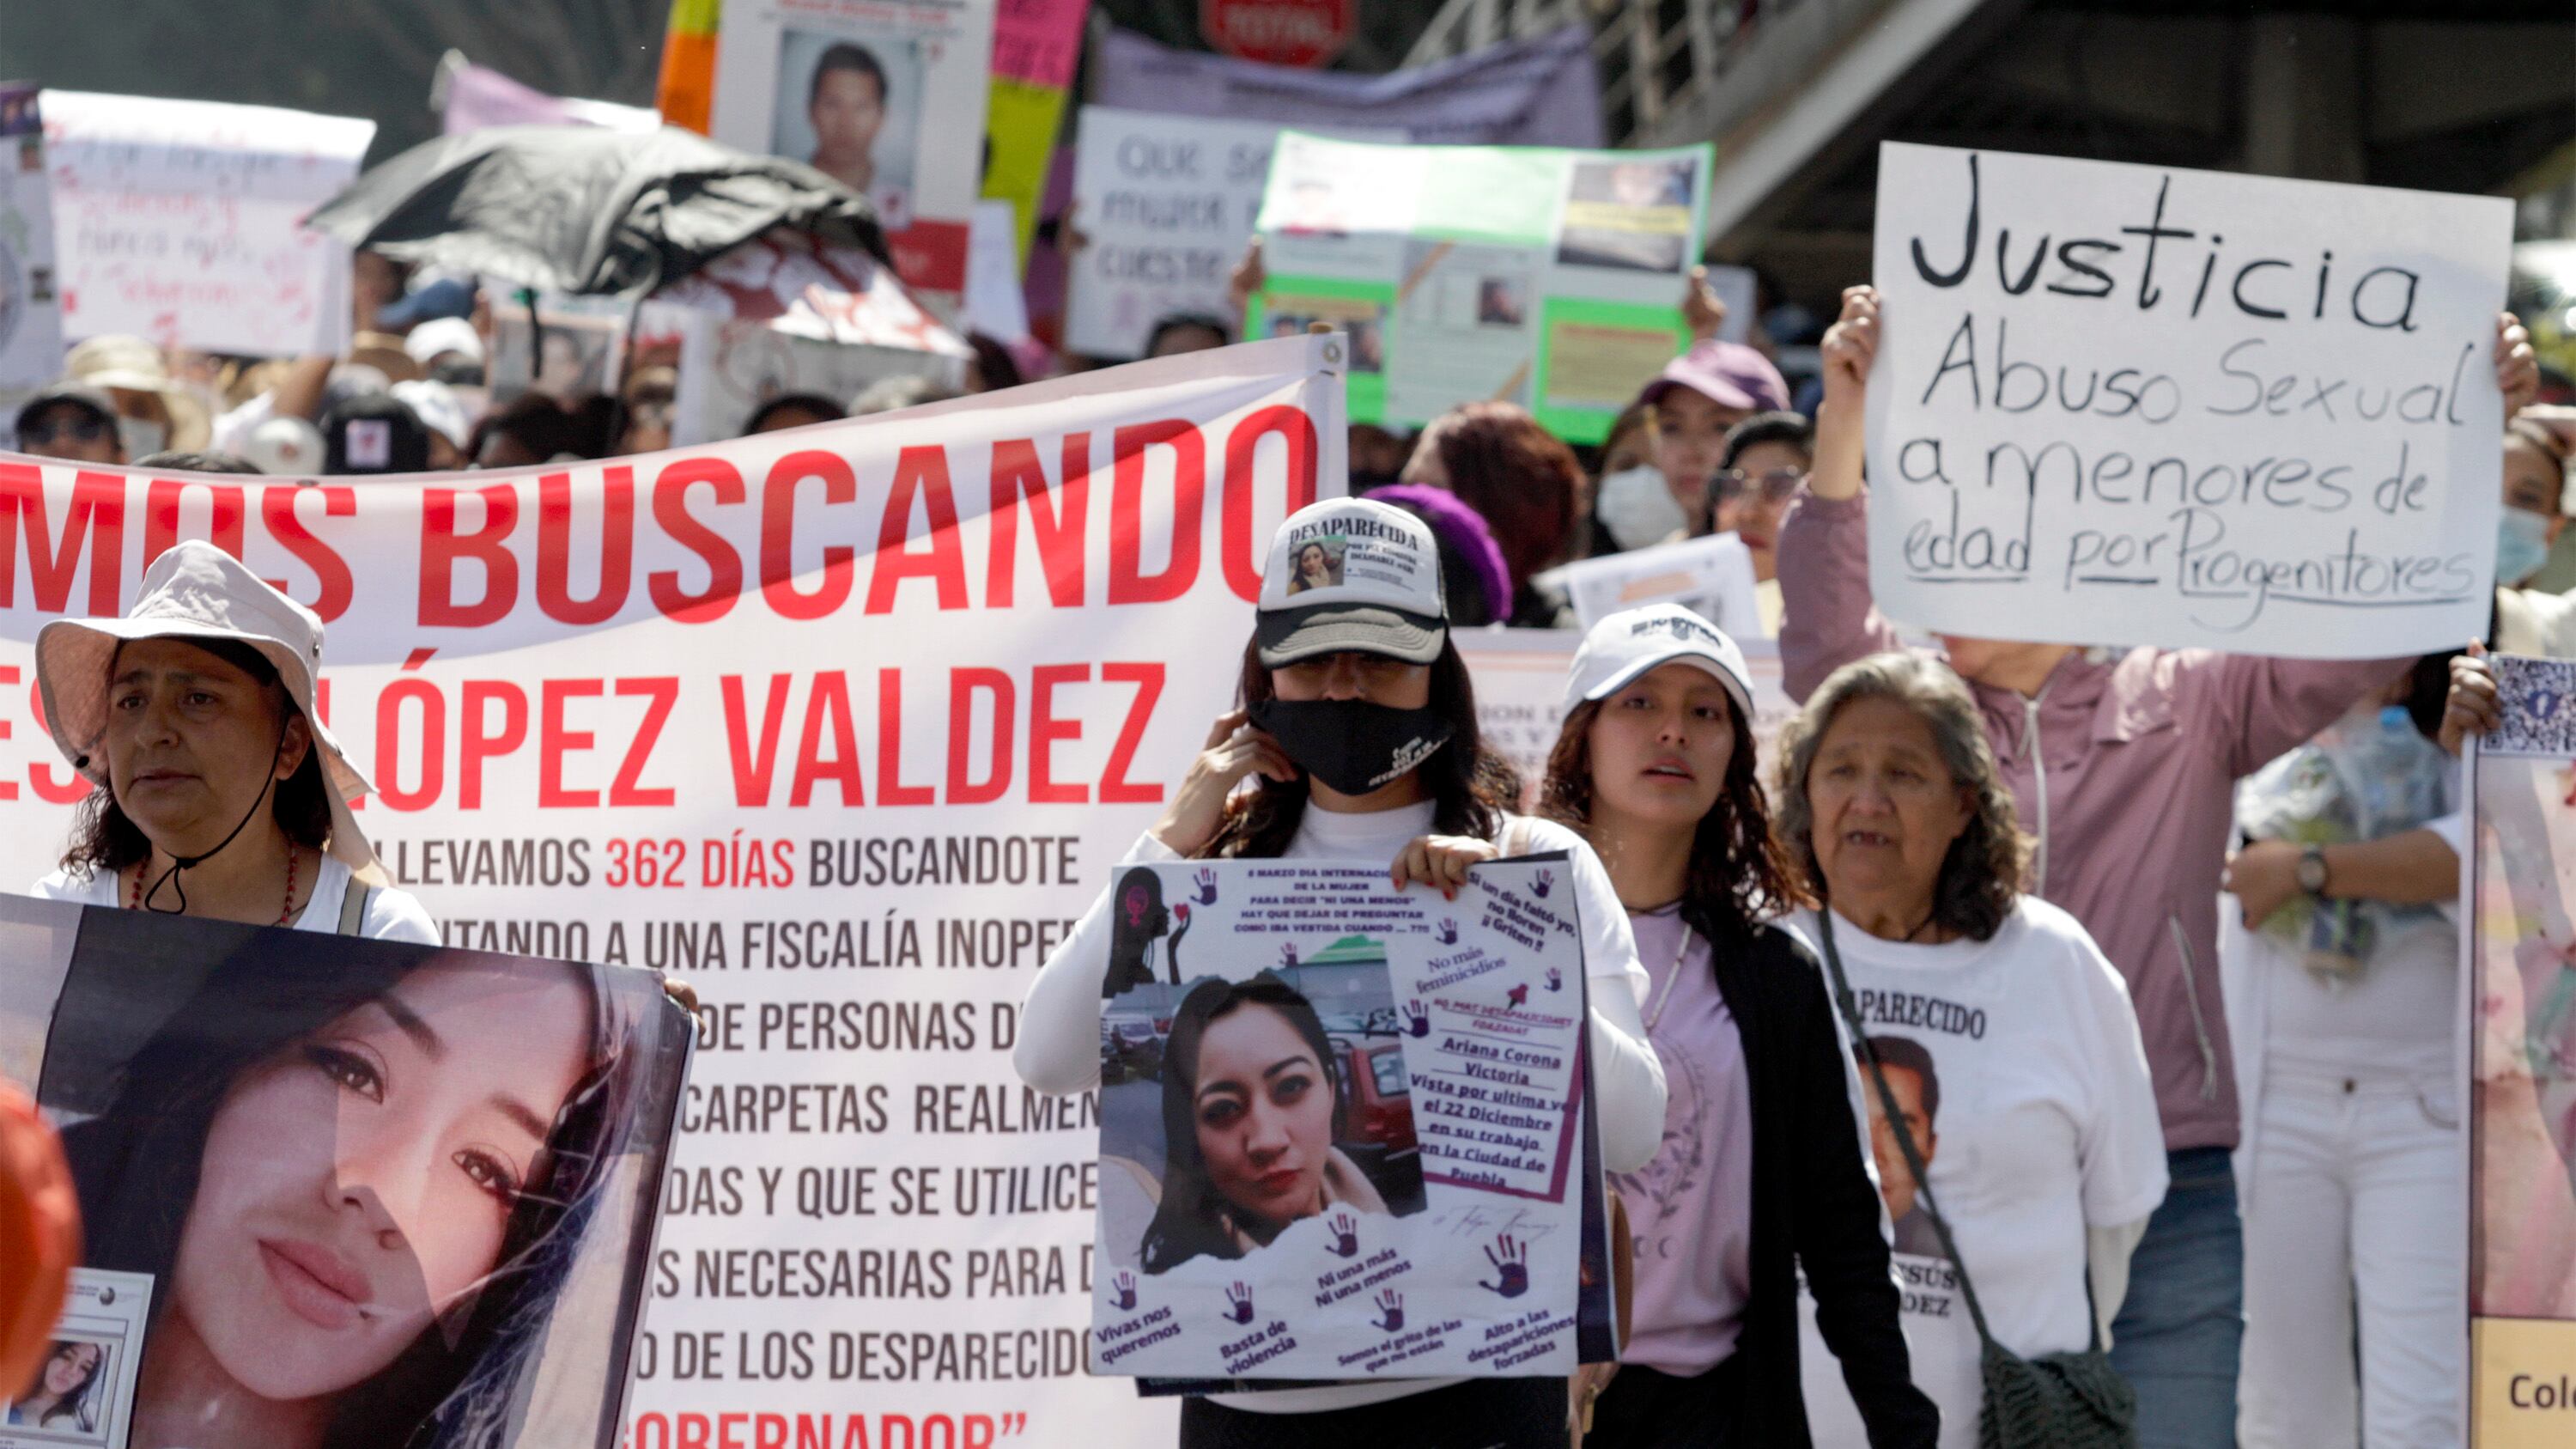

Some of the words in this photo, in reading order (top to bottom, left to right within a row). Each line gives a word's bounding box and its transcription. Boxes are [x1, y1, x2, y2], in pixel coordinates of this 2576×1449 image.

[1911, 154, 2420, 332] Justicia
[1921, 313, 2182, 424] Abuso
[2206, 339, 2476, 426] Sexual
[1899, 439, 1953, 484] a
[2373, 441, 2427, 514] de
[416, 404, 1319, 629] BUSCANDO
[1289, 517, 1419, 551] DESAPARECIDA
[1904, 488, 2032, 572] edad
[2063, 529, 2168, 591] por
[2167, 508, 2477, 633] Progenitores
[720, 661, 1166, 808] VALDEZ
[605, 838, 686, 888] 362
[701, 830, 796, 888] DÍAS
[810, 836, 1080, 886] BUSCANDOTE
[1267, 910, 1290, 919] QUE
[1352, 910, 1425, 919] PREGUNTAR
[1468, 871, 1481, 886] Si
[1482, 880, 1498, 897] un
[1500, 890, 1521, 908] día
[1556, 918, 1577, 938] yo,
[1487, 900, 1504, 916] no
[605, 919, 628, 967] A
[643, 919, 727, 969] UNA
[742, 909, 923, 968] FISCALÍA
[936, 918, 1079, 968] INOPE
[1234, 924, 1267, 933] COMO
[1345, 924, 1394, 933] CUANDO
[1415, 956, 1507, 994] feminicidios
[1427, 957, 1451, 973] No
[1453, 945, 1485, 966] más
[761, 1001, 976, 1050] PERSONAS
[1848, 989, 1987, 1040] PARECIDO
[1443, 1038, 1499, 1058] Ariana
[1504, 1048, 1562, 1070] Corona
[1466, 1062, 1530, 1086] Victoria
[678, 1084, 889, 1135] CARPETAS
[1411, 1074, 1455, 1094] Vista
[1458, 1086, 1489, 1099] por
[1493, 1089, 1546, 1110] ultima
[1424, 1099, 1441, 1113] el
[1444, 1103, 1465, 1118] 22
[1469, 1106, 1552, 1132] Diciembre
[1419, 1143, 1440, 1156] en
[1444, 1145, 1460, 1160] la
[1464, 1149, 1522, 1170] Ciudad
[1525, 1160, 1546, 1173] de
[1429, 1123, 1451, 1135] en
[1455, 1127, 1475, 1141] su
[1479, 1130, 1540, 1153] trabajo
[757, 1166, 783, 1216] Y
[797, 1166, 877, 1220] QUE
[890, 1166, 940, 1216] SE
[954, 1161, 1097, 1217] UTILICE
[1450, 1167, 1508, 1189] Puebla
[694, 1249, 953, 1300] NECESARIAS
[965, 1245, 1066, 1300] PARA
[1315, 1290, 1334, 1308] Ni
[1334, 1282, 1362, 1300] una
[1363, 1259, 1413, 1288] menos
[1317, 1271, 1336, 1288] Ni
[1336, 1263, 1364, 1282] una
[1365, 1248, 1397, 1269] más
[1097, 1319, 1141, 1344] Vivas
[1142, 1306, 1172, 1326] nos
[1101, 1322, 1182, 1366] queremos
[1220, 1333, 1266, 1359] Basta
[1267, 1320, 1288, 1338] de
[1337, 1346, 1379, 1367] Somos
[1380, 1339, 1391, 1352] el
[1393, 1332, 1424, 1351] grito
[1425, 1325, 1442, 1337] de
[1443, 1318, 1462, 1332] las
[1467, 1316, 1575, 1363] desapariciones
[1485, 1323, 1515, 1342] Alto
[1516, 1318, 1526, 1329] a
[1527, 1309, 1550, 1324] las
[672, 1330, 725, 1381] DE
[739, 1331, 815, 1381] LOS
[1225, 1336, 1297, 1376] violencia
[1365, 1357, 1388, 1373] que
[1390, 1352, 1407, 1363] no
[1492, 1341, 1557, 1371] forzadas
[2509, 1374, 2576, 1409] Col
